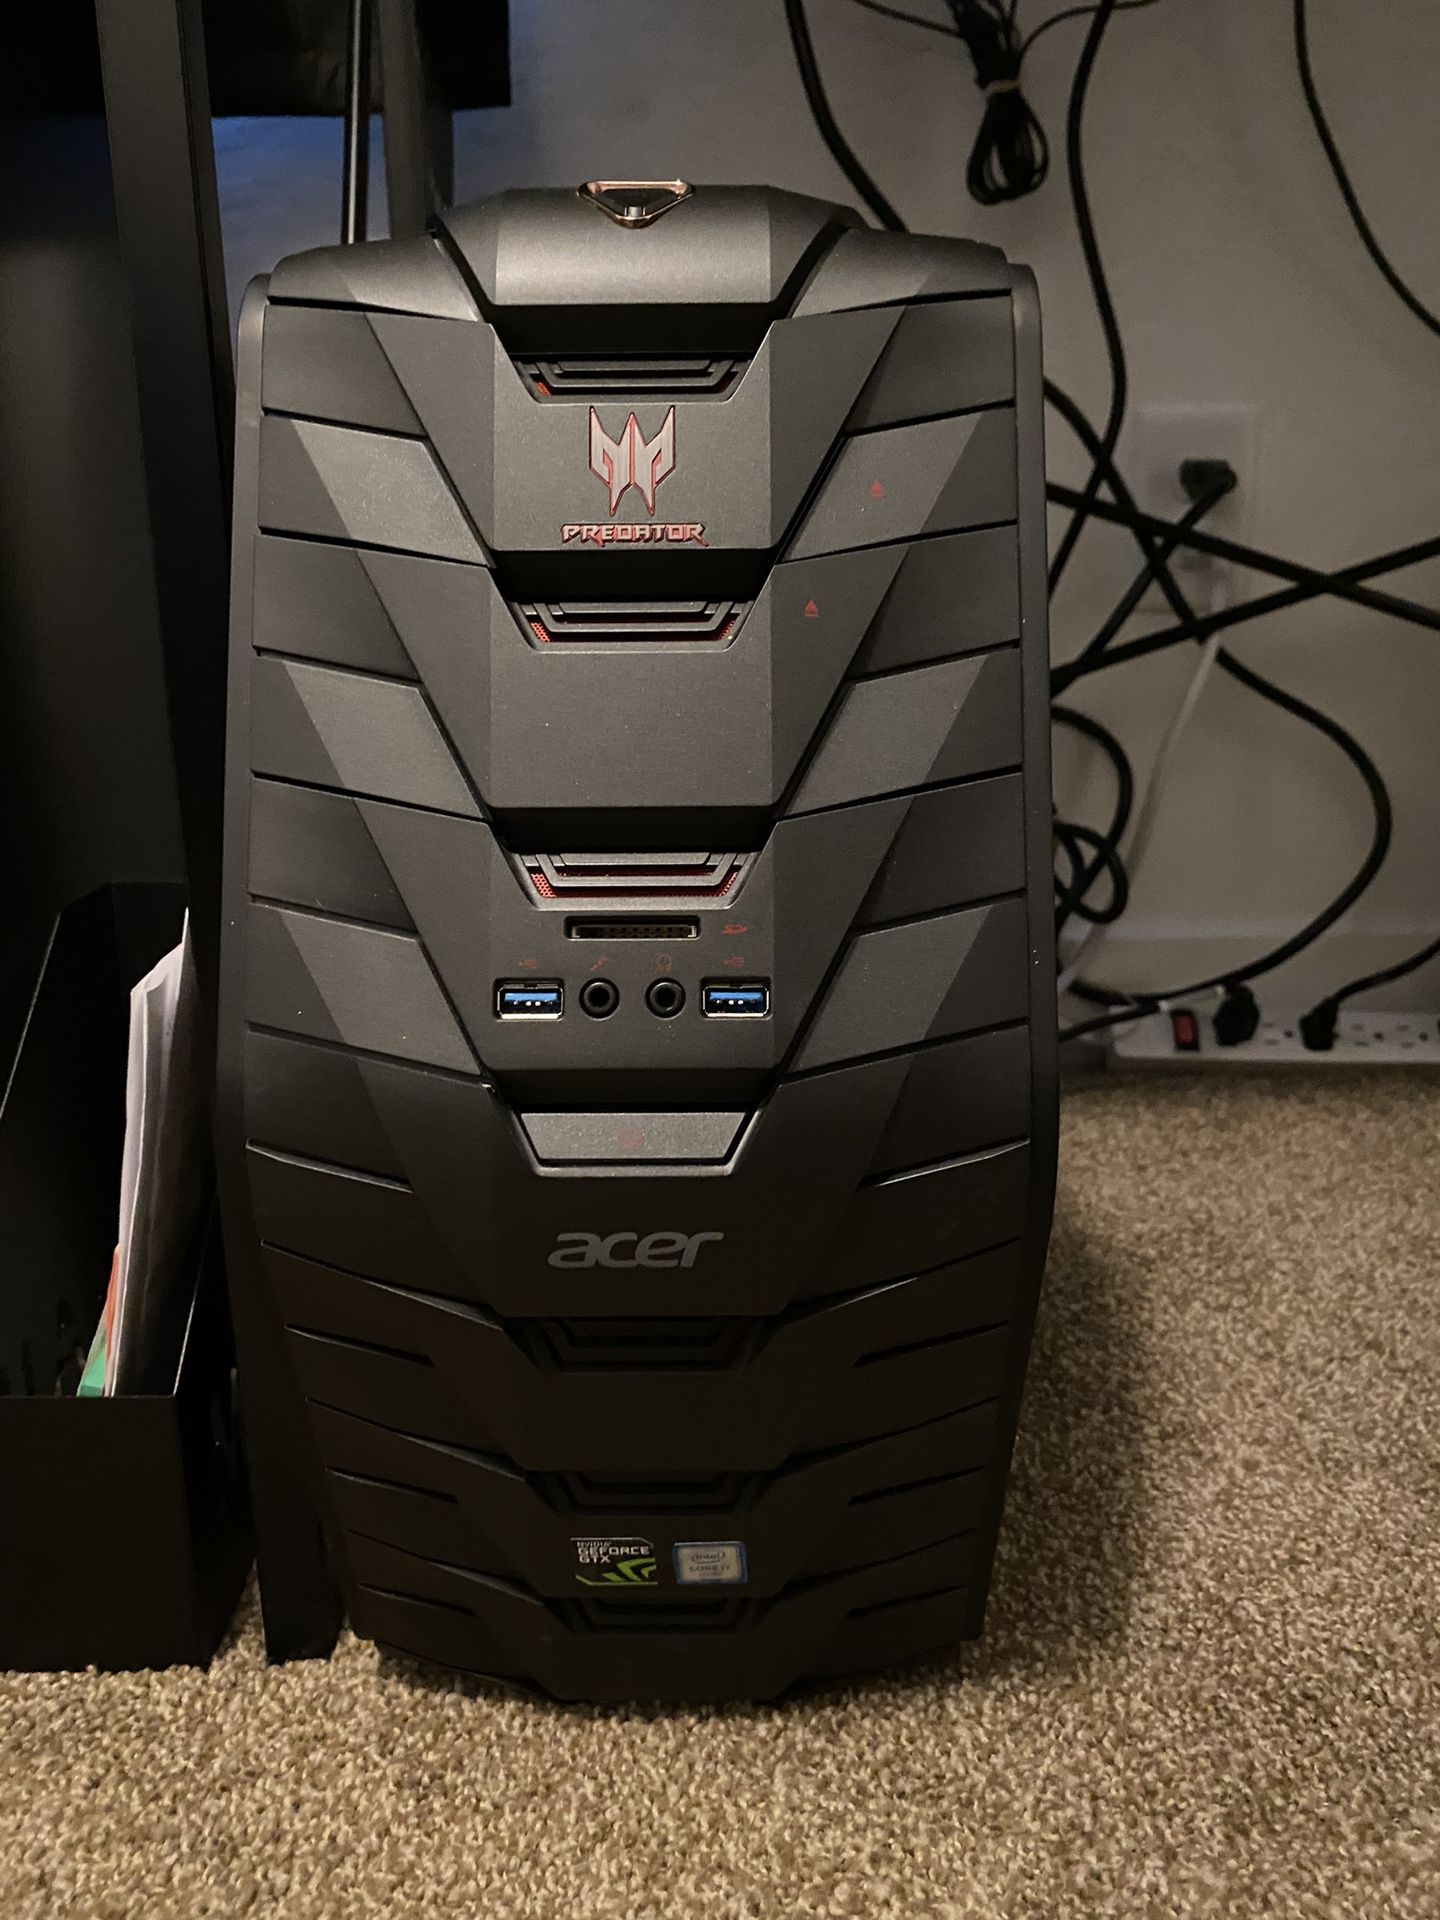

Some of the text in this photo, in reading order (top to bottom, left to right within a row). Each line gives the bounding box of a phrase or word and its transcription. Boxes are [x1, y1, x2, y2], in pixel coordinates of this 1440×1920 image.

[561, 523, 709, 547] PREDATOR
[547, 1231, 724, 1269] acer
[577, 1546, 650, 1555] GEFORCE
[579, 1554, 611, 1564] GTX
